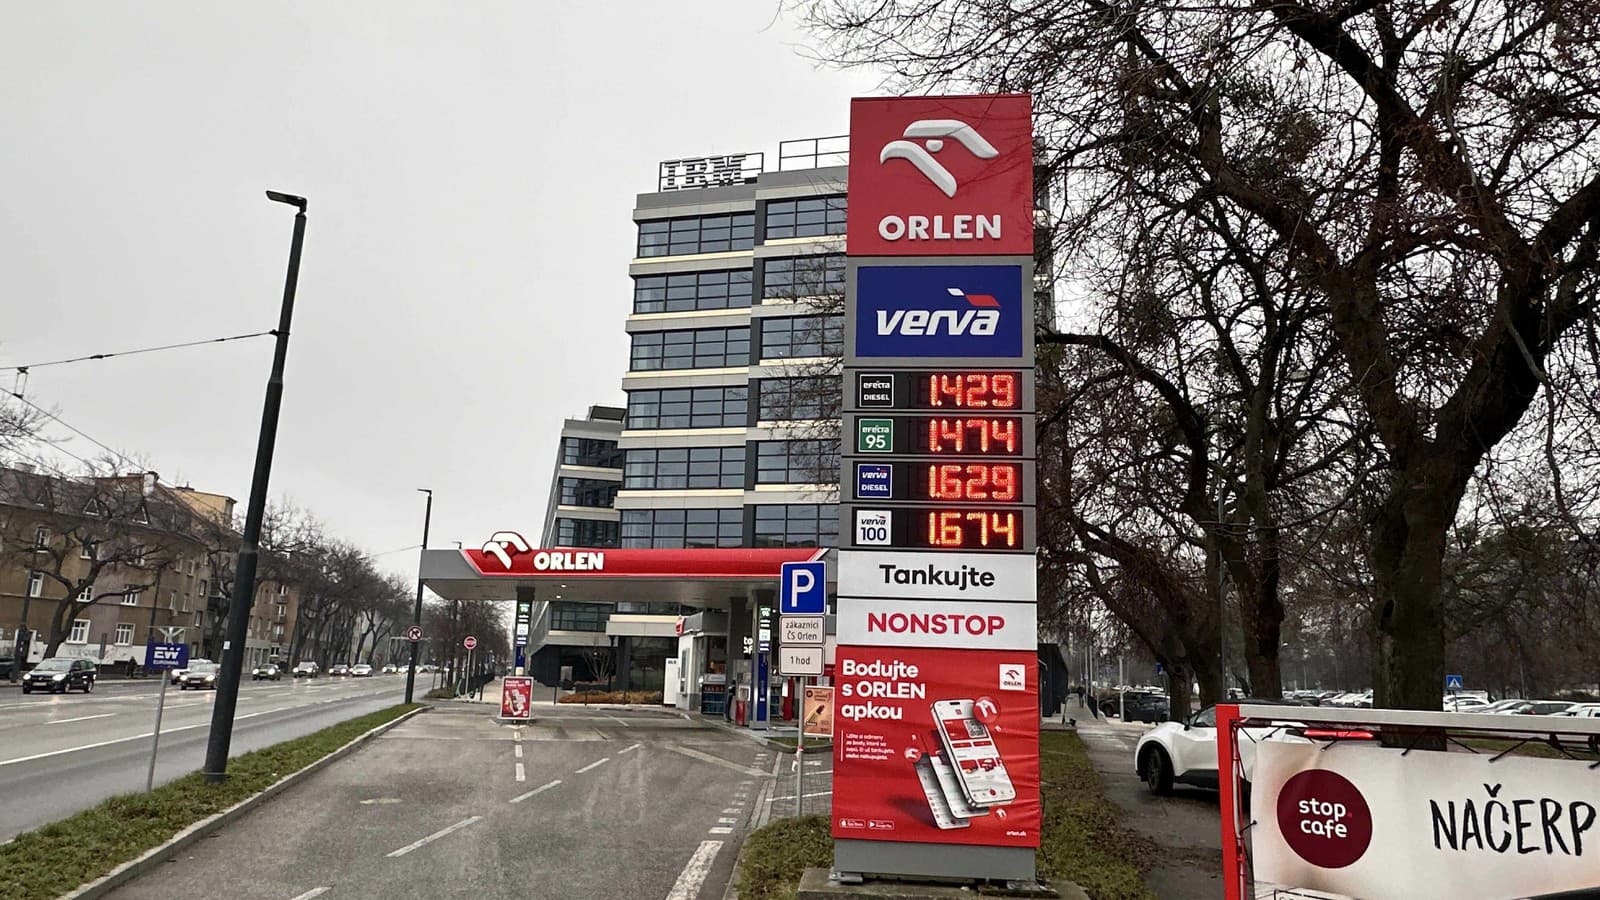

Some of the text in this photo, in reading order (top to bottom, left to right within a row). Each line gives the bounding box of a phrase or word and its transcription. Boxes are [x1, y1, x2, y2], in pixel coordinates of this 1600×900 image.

[663, 152, 746, 190] IBM
[878, 214, 1001, 241] ORLEN
[876, 309, 1001, 336] verva
[930, 374, 1014, 407] 1.429
[865, 434, 886, 449] 95
[929, 419, 1014, 453] 1.474
[861, 470, 888, 479] verva
[929, 464, 1014, 499] 1.629
[861, 484, 888, 492] DIESEL
[860, 517, 887, 526] verva
[928, 511, 1014, 547] 1.674
[860, 527, 887, 541] 100
[533, 552, 604, 570] ORLEN
[791, 569, 815, 608] P
[879, 564, 995, 591] Tankujte
[787, 630, 817, 640] ČS Orlen
[867, 612, 1005, 636] NONSTOP
[790, 655, 811, 665] 1 hod
[842, 659, 919, 681] Bodujte
[841, 683, 853, 697] s
[856, 680, 926, 699] ORLEN
[841, 700, 903, 721] apkou
[1300, 819, 1348, 839] cafe
[1429, 783, 1597, 857] NAČERP
